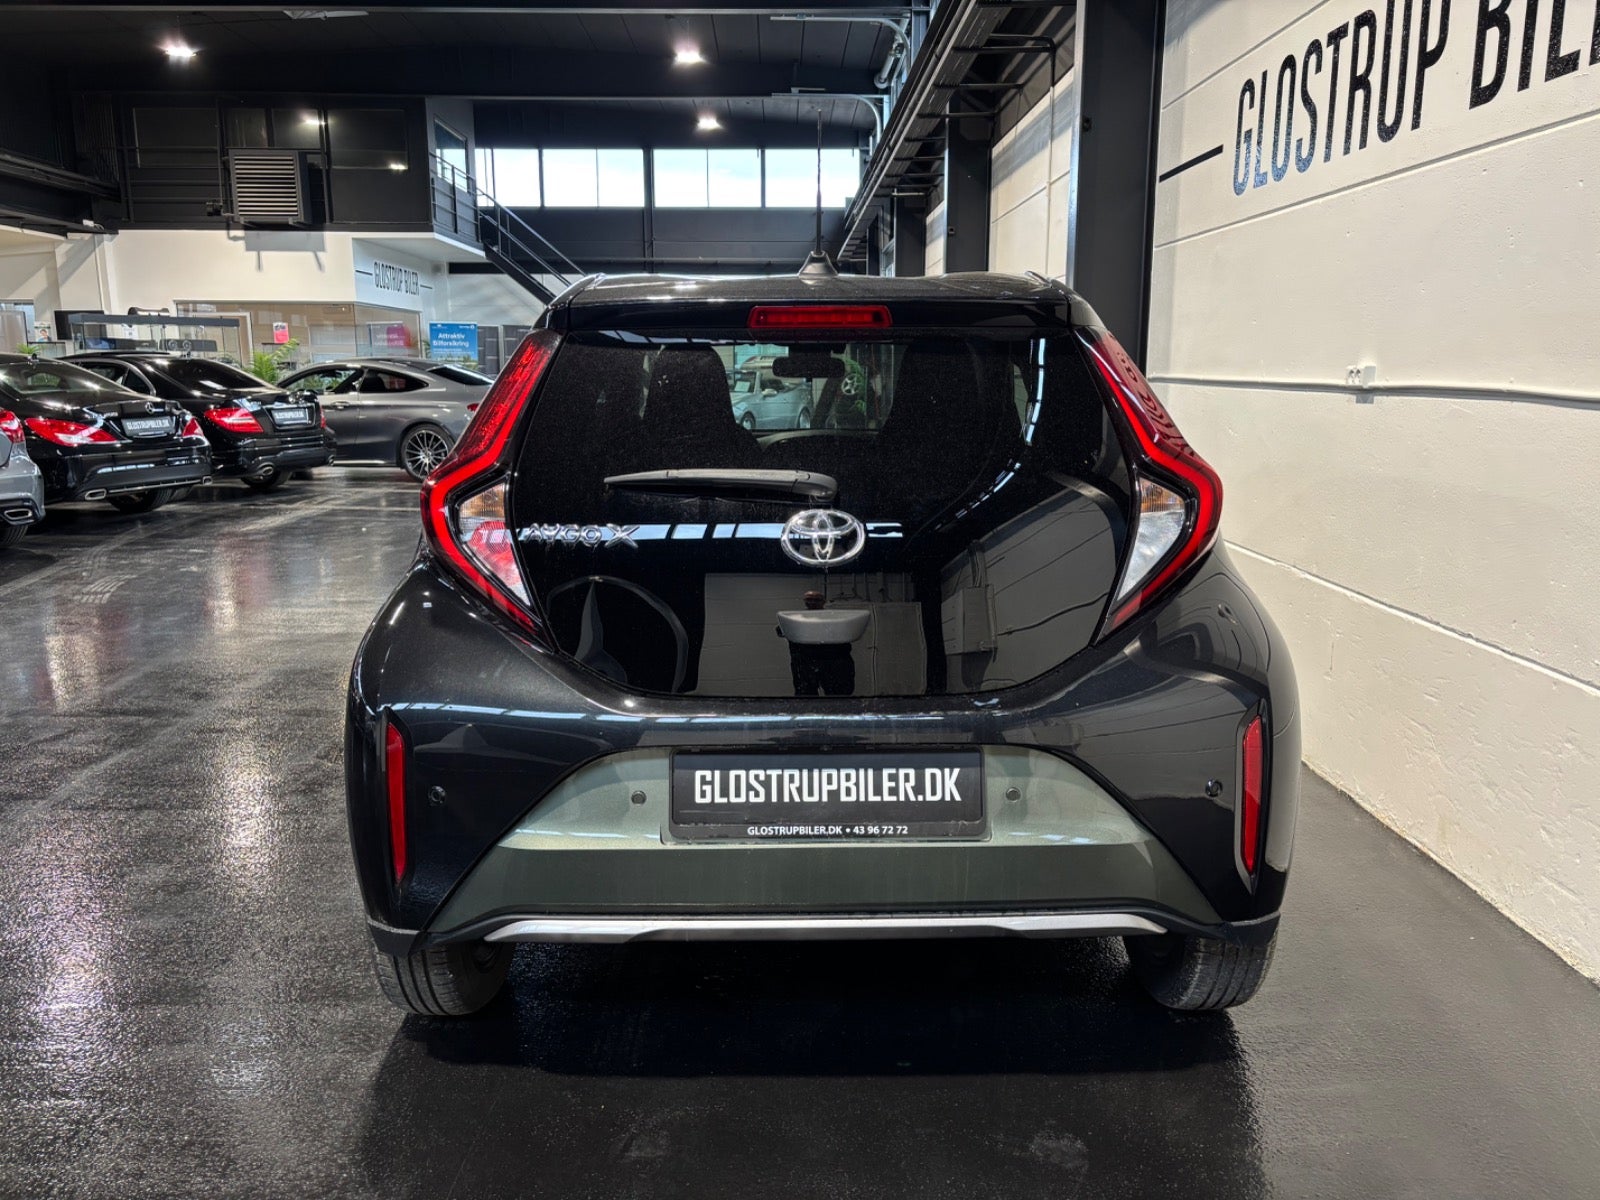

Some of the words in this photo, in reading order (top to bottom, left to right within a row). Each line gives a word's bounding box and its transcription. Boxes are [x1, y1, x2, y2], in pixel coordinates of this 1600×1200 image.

[1233, 0, 1451, 196] GLOSTRUP
[374, 261, 403, 293] GLOSTRUP
[524, 523, 602, 547] AYGO
[604, 523, 640, 548] X
[695, 768, 962, 804] GLOSTRUPBILER.DK
[747, 826, 842, 836] GLOSTRUPBILER.DK
[852, 825, 866, 835] 43
[867, 825, 880, 835] 96
[881, 825, 894, 835] 72
[895, 825, 908, 835] 72
